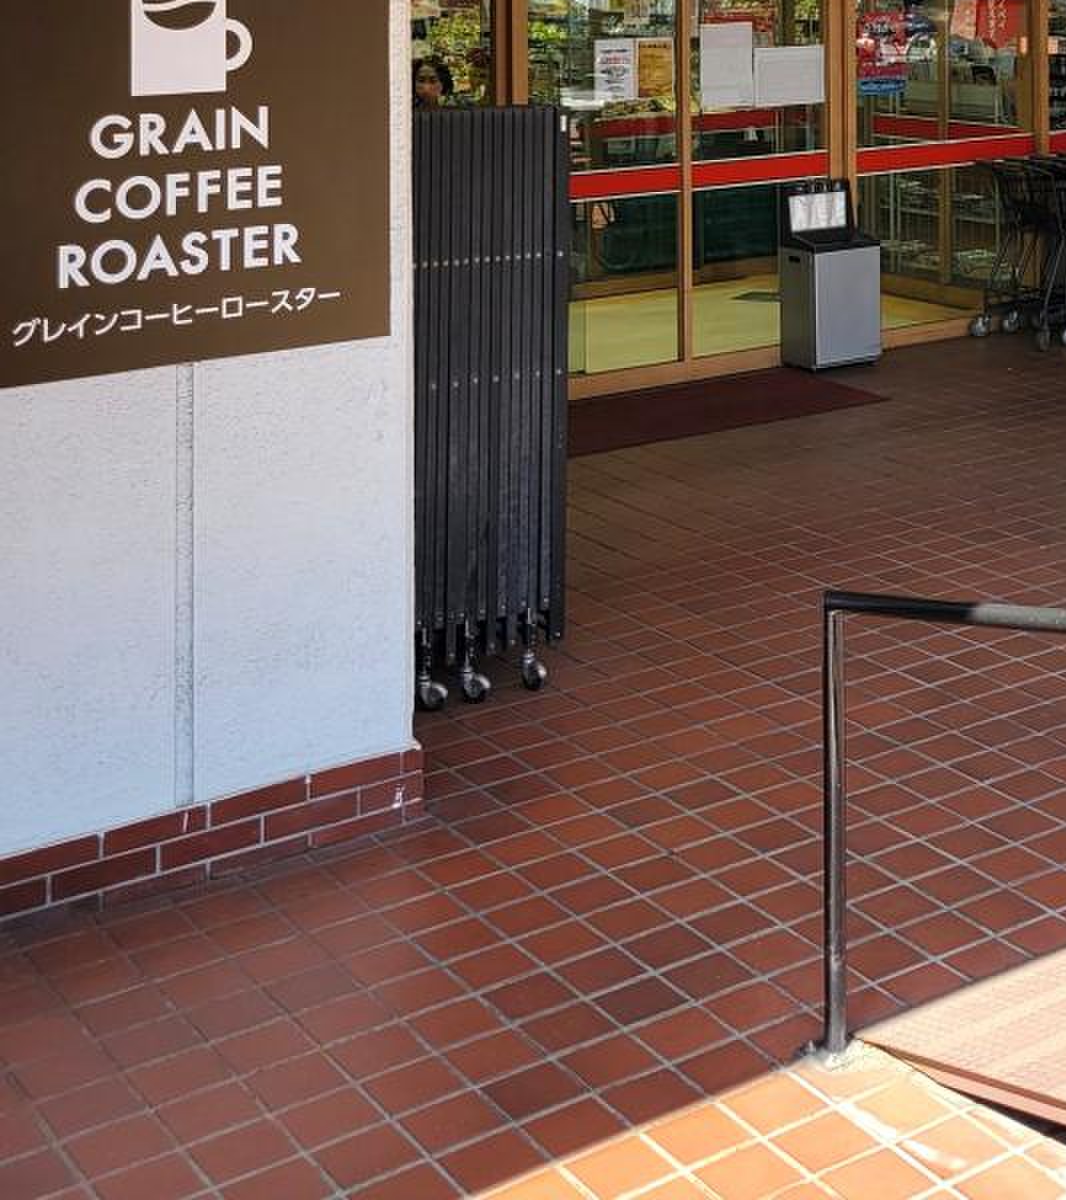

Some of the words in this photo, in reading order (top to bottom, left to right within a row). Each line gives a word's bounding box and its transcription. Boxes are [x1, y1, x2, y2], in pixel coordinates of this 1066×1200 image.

[89, 105, 270, 159] GRAIN
[74, 164, 283, 224] COFFEE
[57, 222, 301, 290] ROASTER
[12, 286, 341, 347] グレインコーヒーロースター
